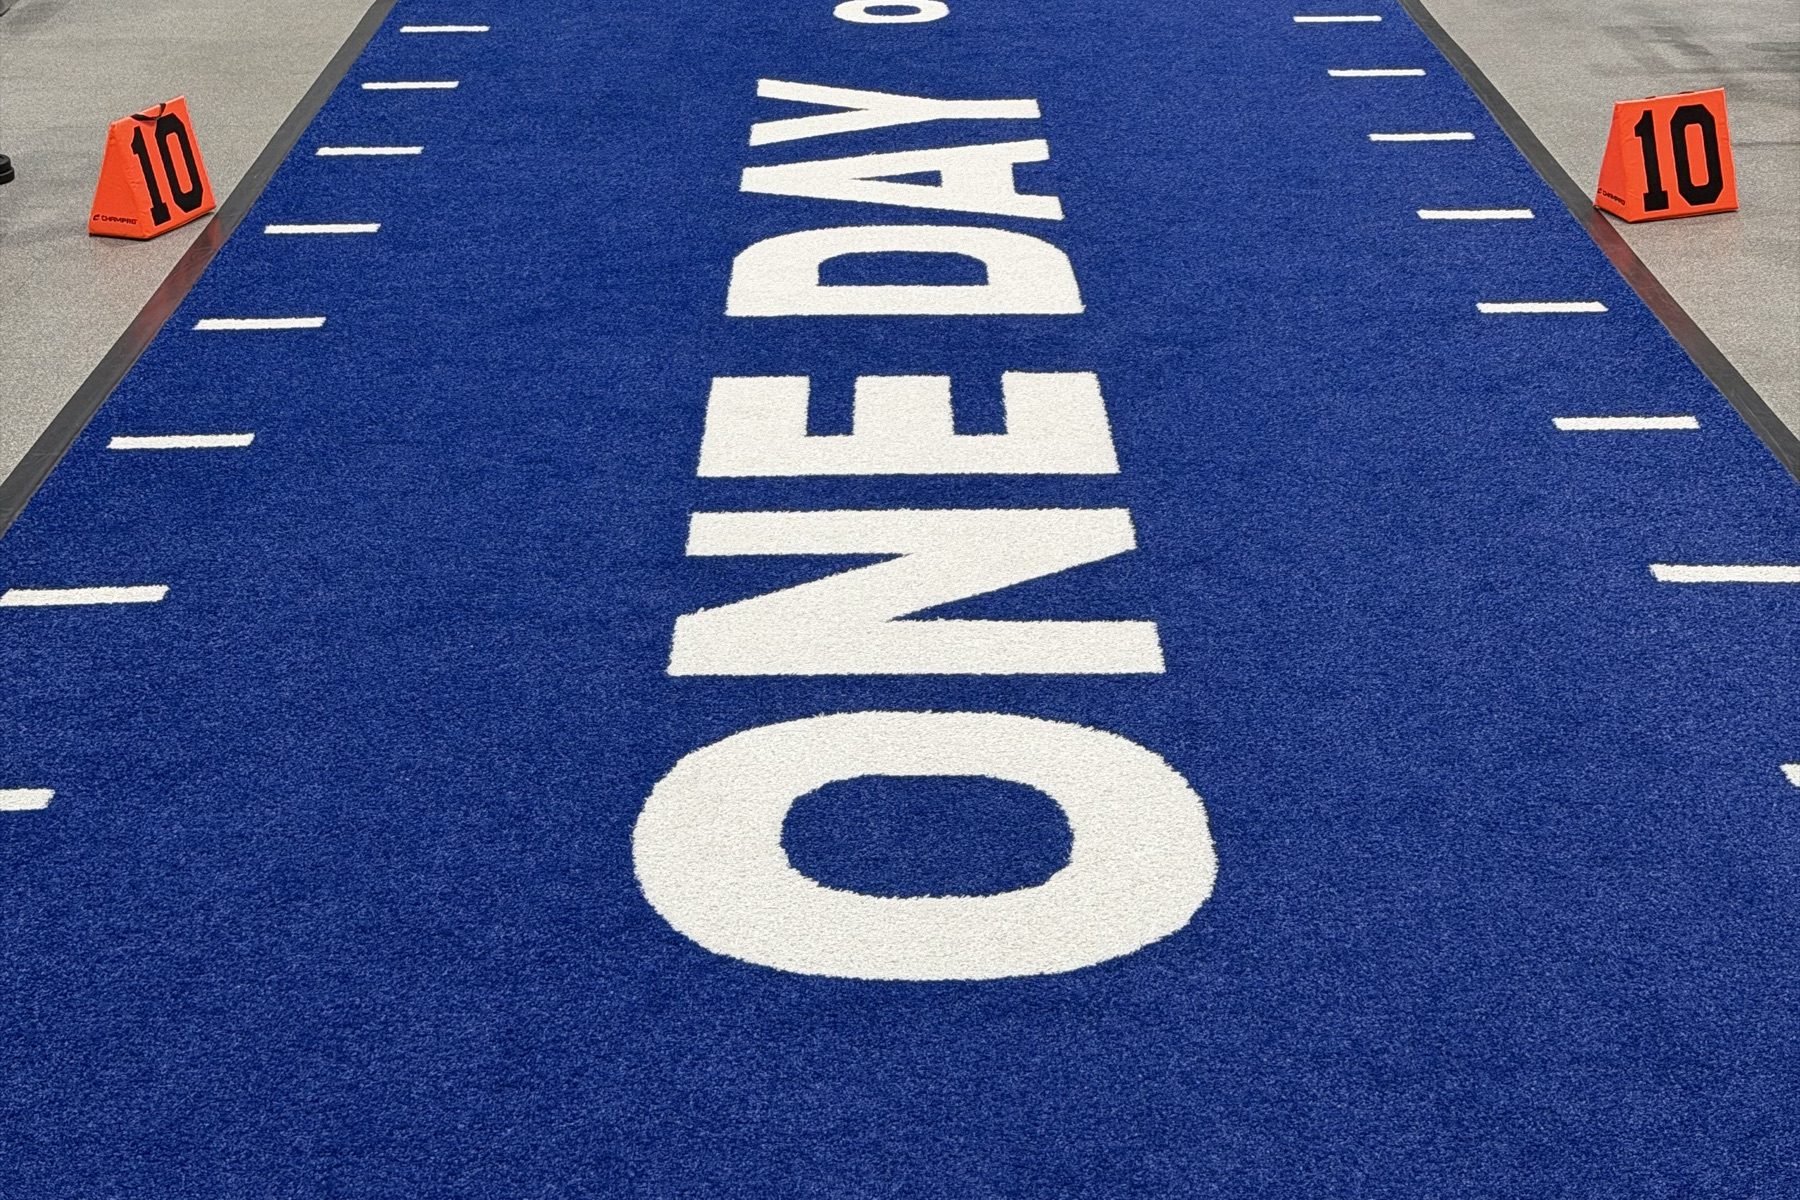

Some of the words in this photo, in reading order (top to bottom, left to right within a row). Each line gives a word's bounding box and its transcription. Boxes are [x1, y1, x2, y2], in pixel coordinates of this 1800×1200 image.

[131, 112, 204, 227] 10
[724, 79, 1086, 318] DAY
[1634, 103, 1724, 212] 10
[100, 215, 138, 225] CHAMPRO
[632, 371, 1218, 981] ONE
